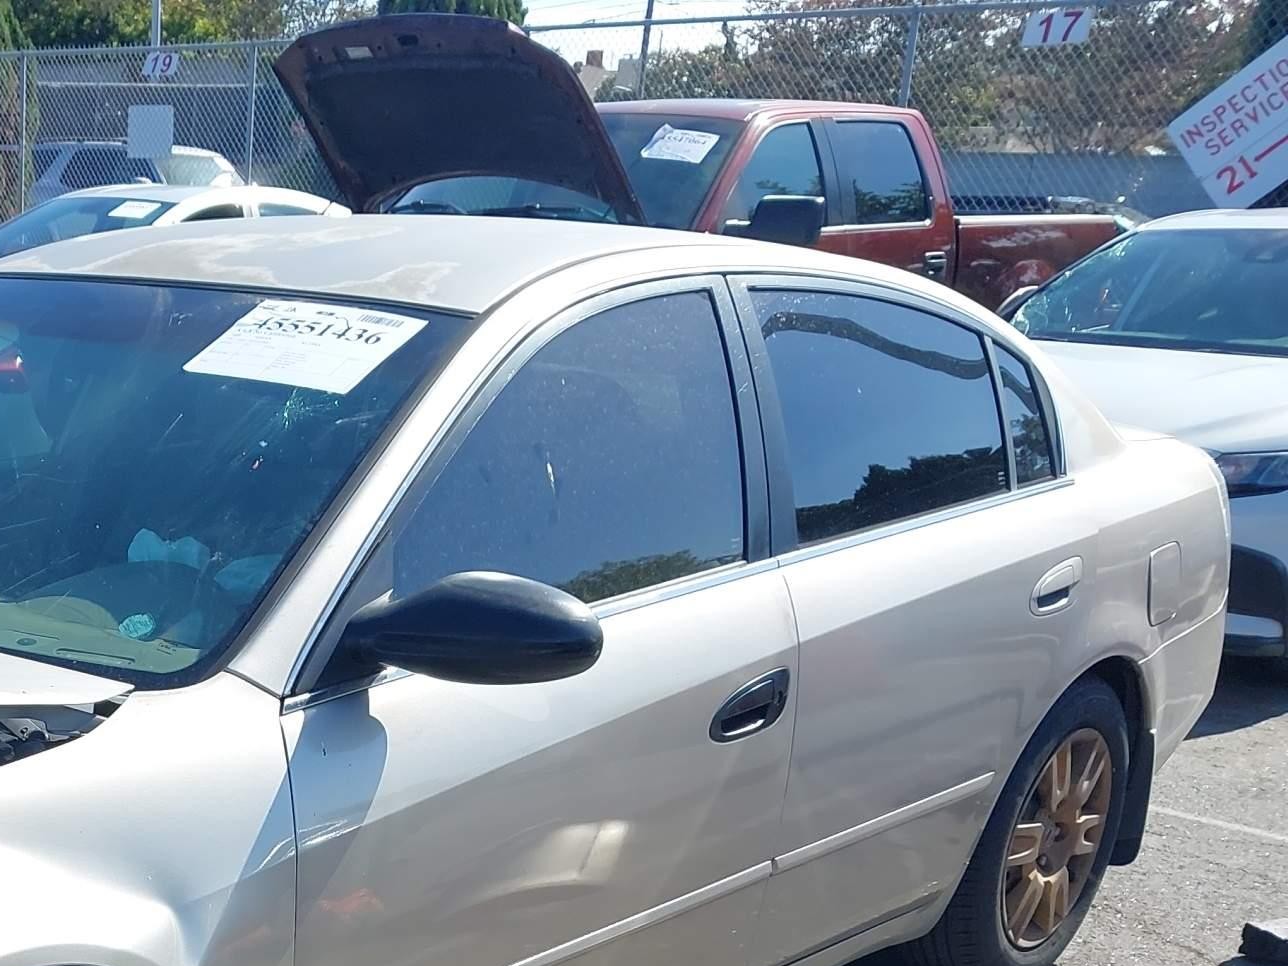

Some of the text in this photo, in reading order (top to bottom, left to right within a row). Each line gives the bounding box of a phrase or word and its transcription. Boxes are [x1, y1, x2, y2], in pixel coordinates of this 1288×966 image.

[1039, 10, 1084, 43] 17
[150, 54, 173, 73] 19
[252, 315, 387, 346] 45551436
